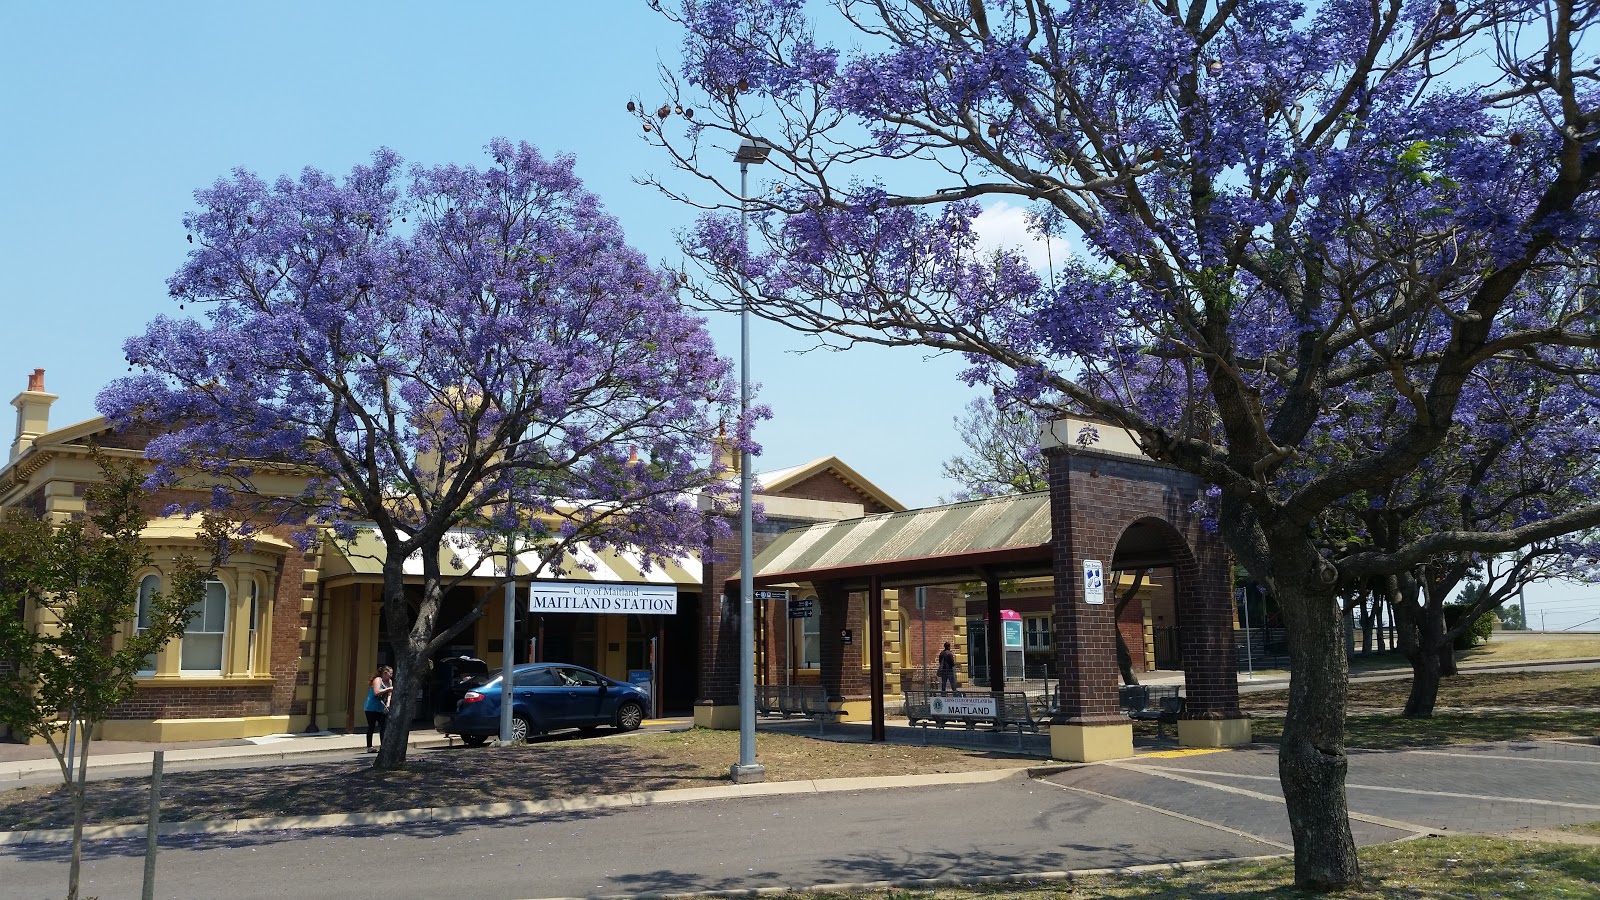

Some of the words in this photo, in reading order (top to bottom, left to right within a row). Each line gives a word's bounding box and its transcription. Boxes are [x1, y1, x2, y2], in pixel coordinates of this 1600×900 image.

[573, 586, 591, 598] City
[593, 586, 603, 596] of
[604, 587, 639, 597] Maitland
[533, 597, 611, 609] MAITLAND
[614, 598, 674, 611] STATION
[948, 706, 990, 715] MAITLAND
